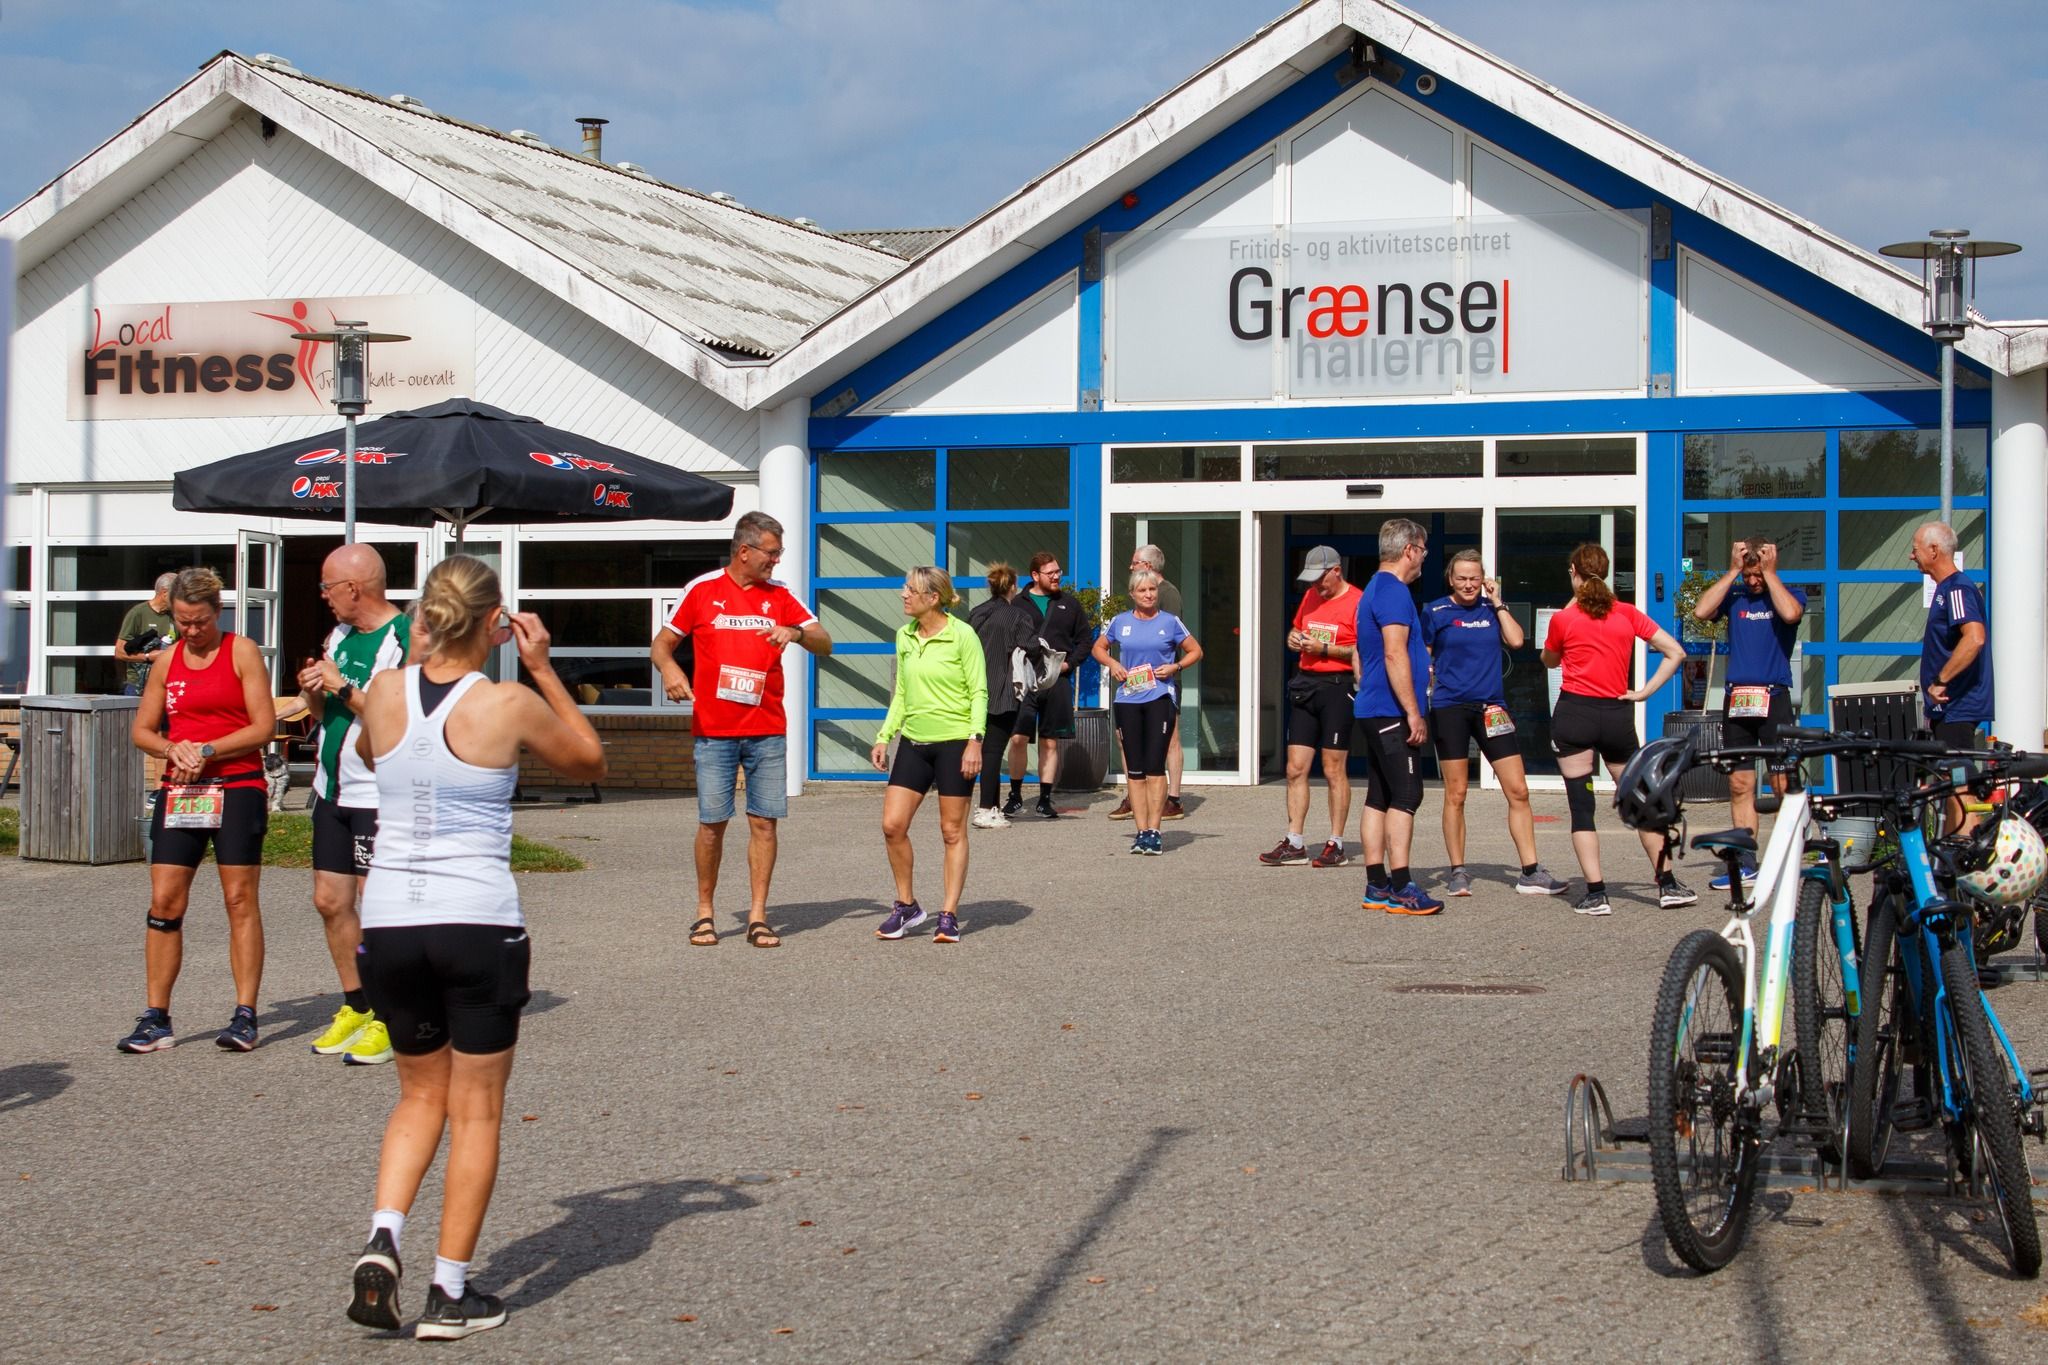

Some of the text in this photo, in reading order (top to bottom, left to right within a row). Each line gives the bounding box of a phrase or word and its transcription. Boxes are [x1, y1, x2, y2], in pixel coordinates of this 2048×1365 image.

[1229, 231, 1512, 261] Fritids- og aktivitetscentret
[1229, 266, 1498, 341] Grænse
[89, 304, 174, 358] Local
[84, 349, 295, 396] Fitness
[1297, 328, 1497, 379] hallerne
[408, 369, 456, 387] overalt
[729, 617, 772, 628] BYGMA
[729, 677, 755, 692] 100
